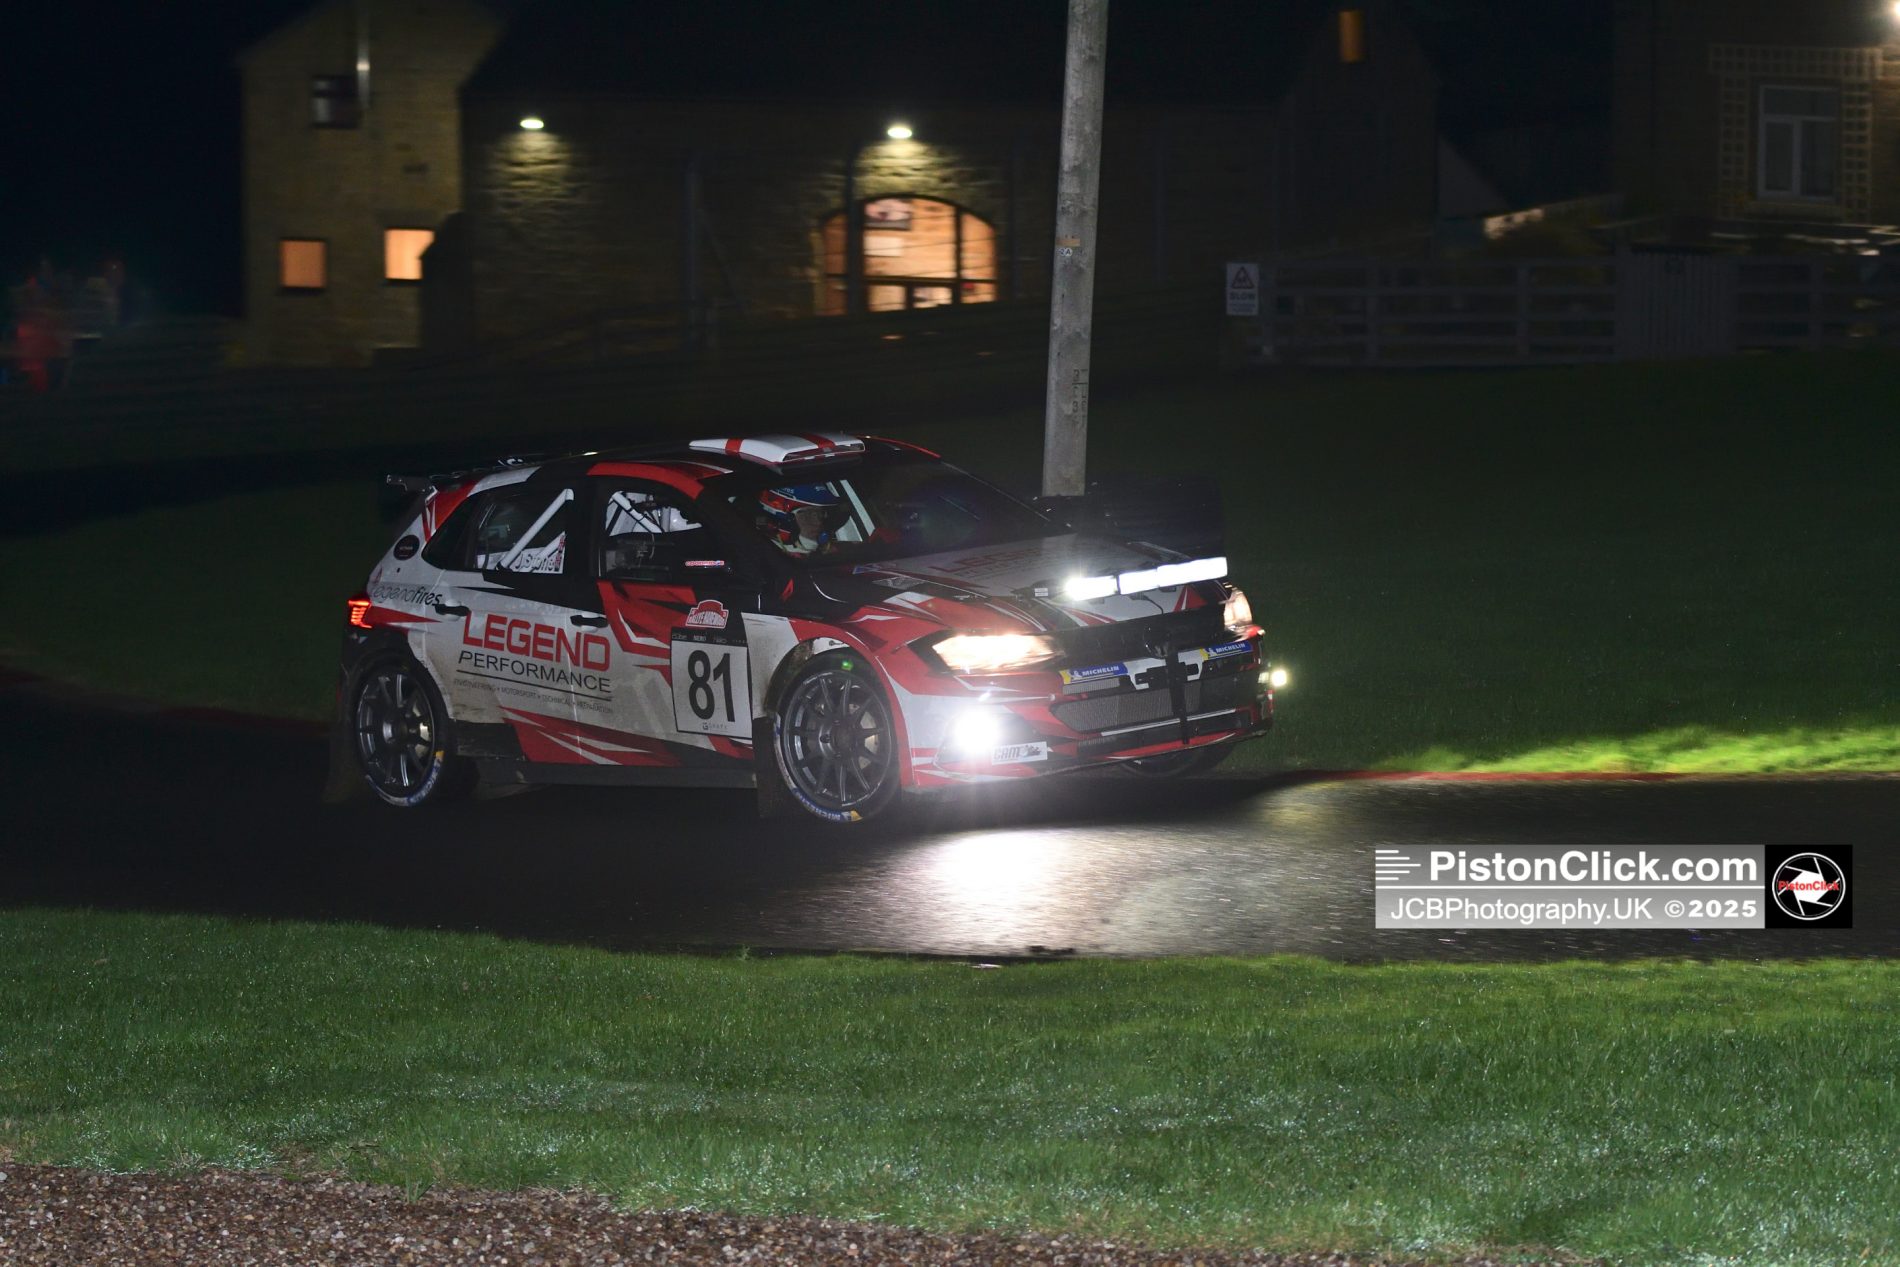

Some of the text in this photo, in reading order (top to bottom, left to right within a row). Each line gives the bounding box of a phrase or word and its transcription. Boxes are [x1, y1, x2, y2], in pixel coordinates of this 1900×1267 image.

[463, 610, 611, 672] LEGEND
[1215, 643, 1245, 653] MICHELIN
[458, 650, 612, 693] PERFORMANCE
[687, 649, 736, 722] 81
[1082, 665, 1120, 677] MICHELIN
